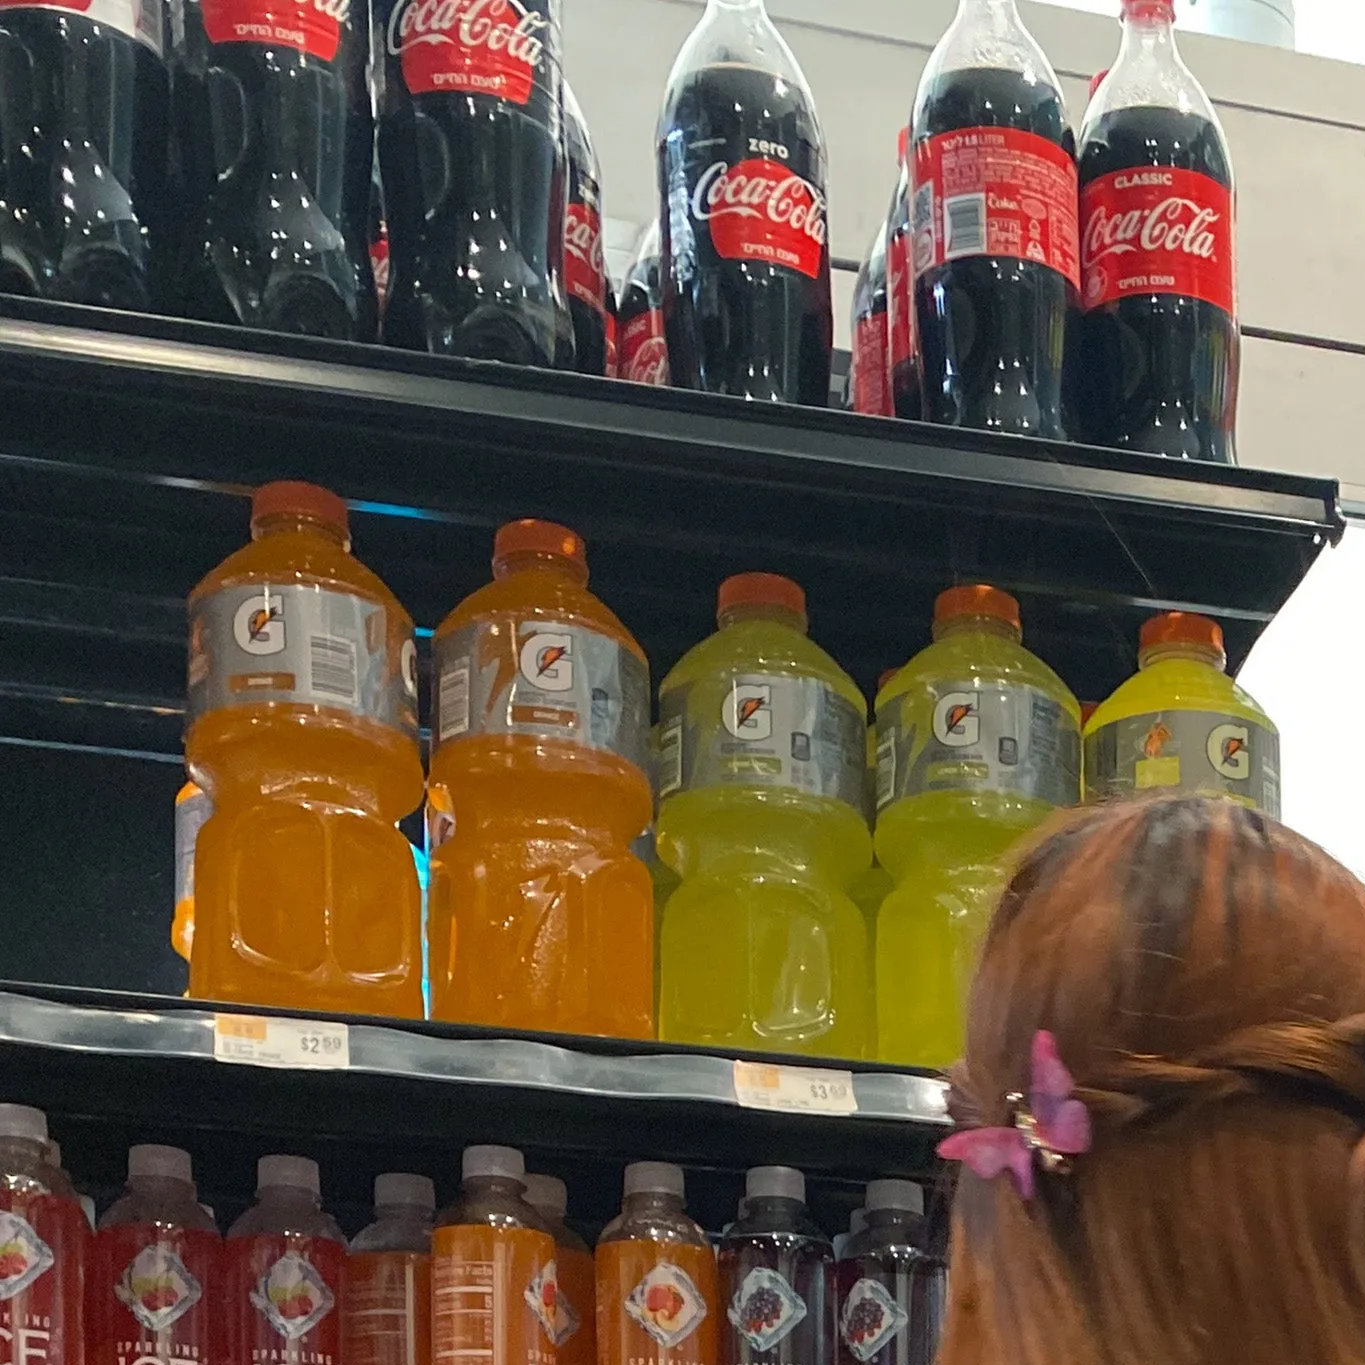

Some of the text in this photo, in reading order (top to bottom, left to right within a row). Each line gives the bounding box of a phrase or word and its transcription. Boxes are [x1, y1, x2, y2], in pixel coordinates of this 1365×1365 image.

[388, 0, 550, 68] Coca-Cola
[748, 138, 789, 160] zero
[691, 161, 828, 246] Coca-Cola
[1114, 171, 1173, 190] CLASSIC
[1082, 197, 1220, 269] Coca-Cola
[233, 595, 286, 657] G
[520, 633, 576, 691] G
[712, 683, 773, 740] G
[933, 691, 981, 747] G
[1206, 724, 1250, 780] G
